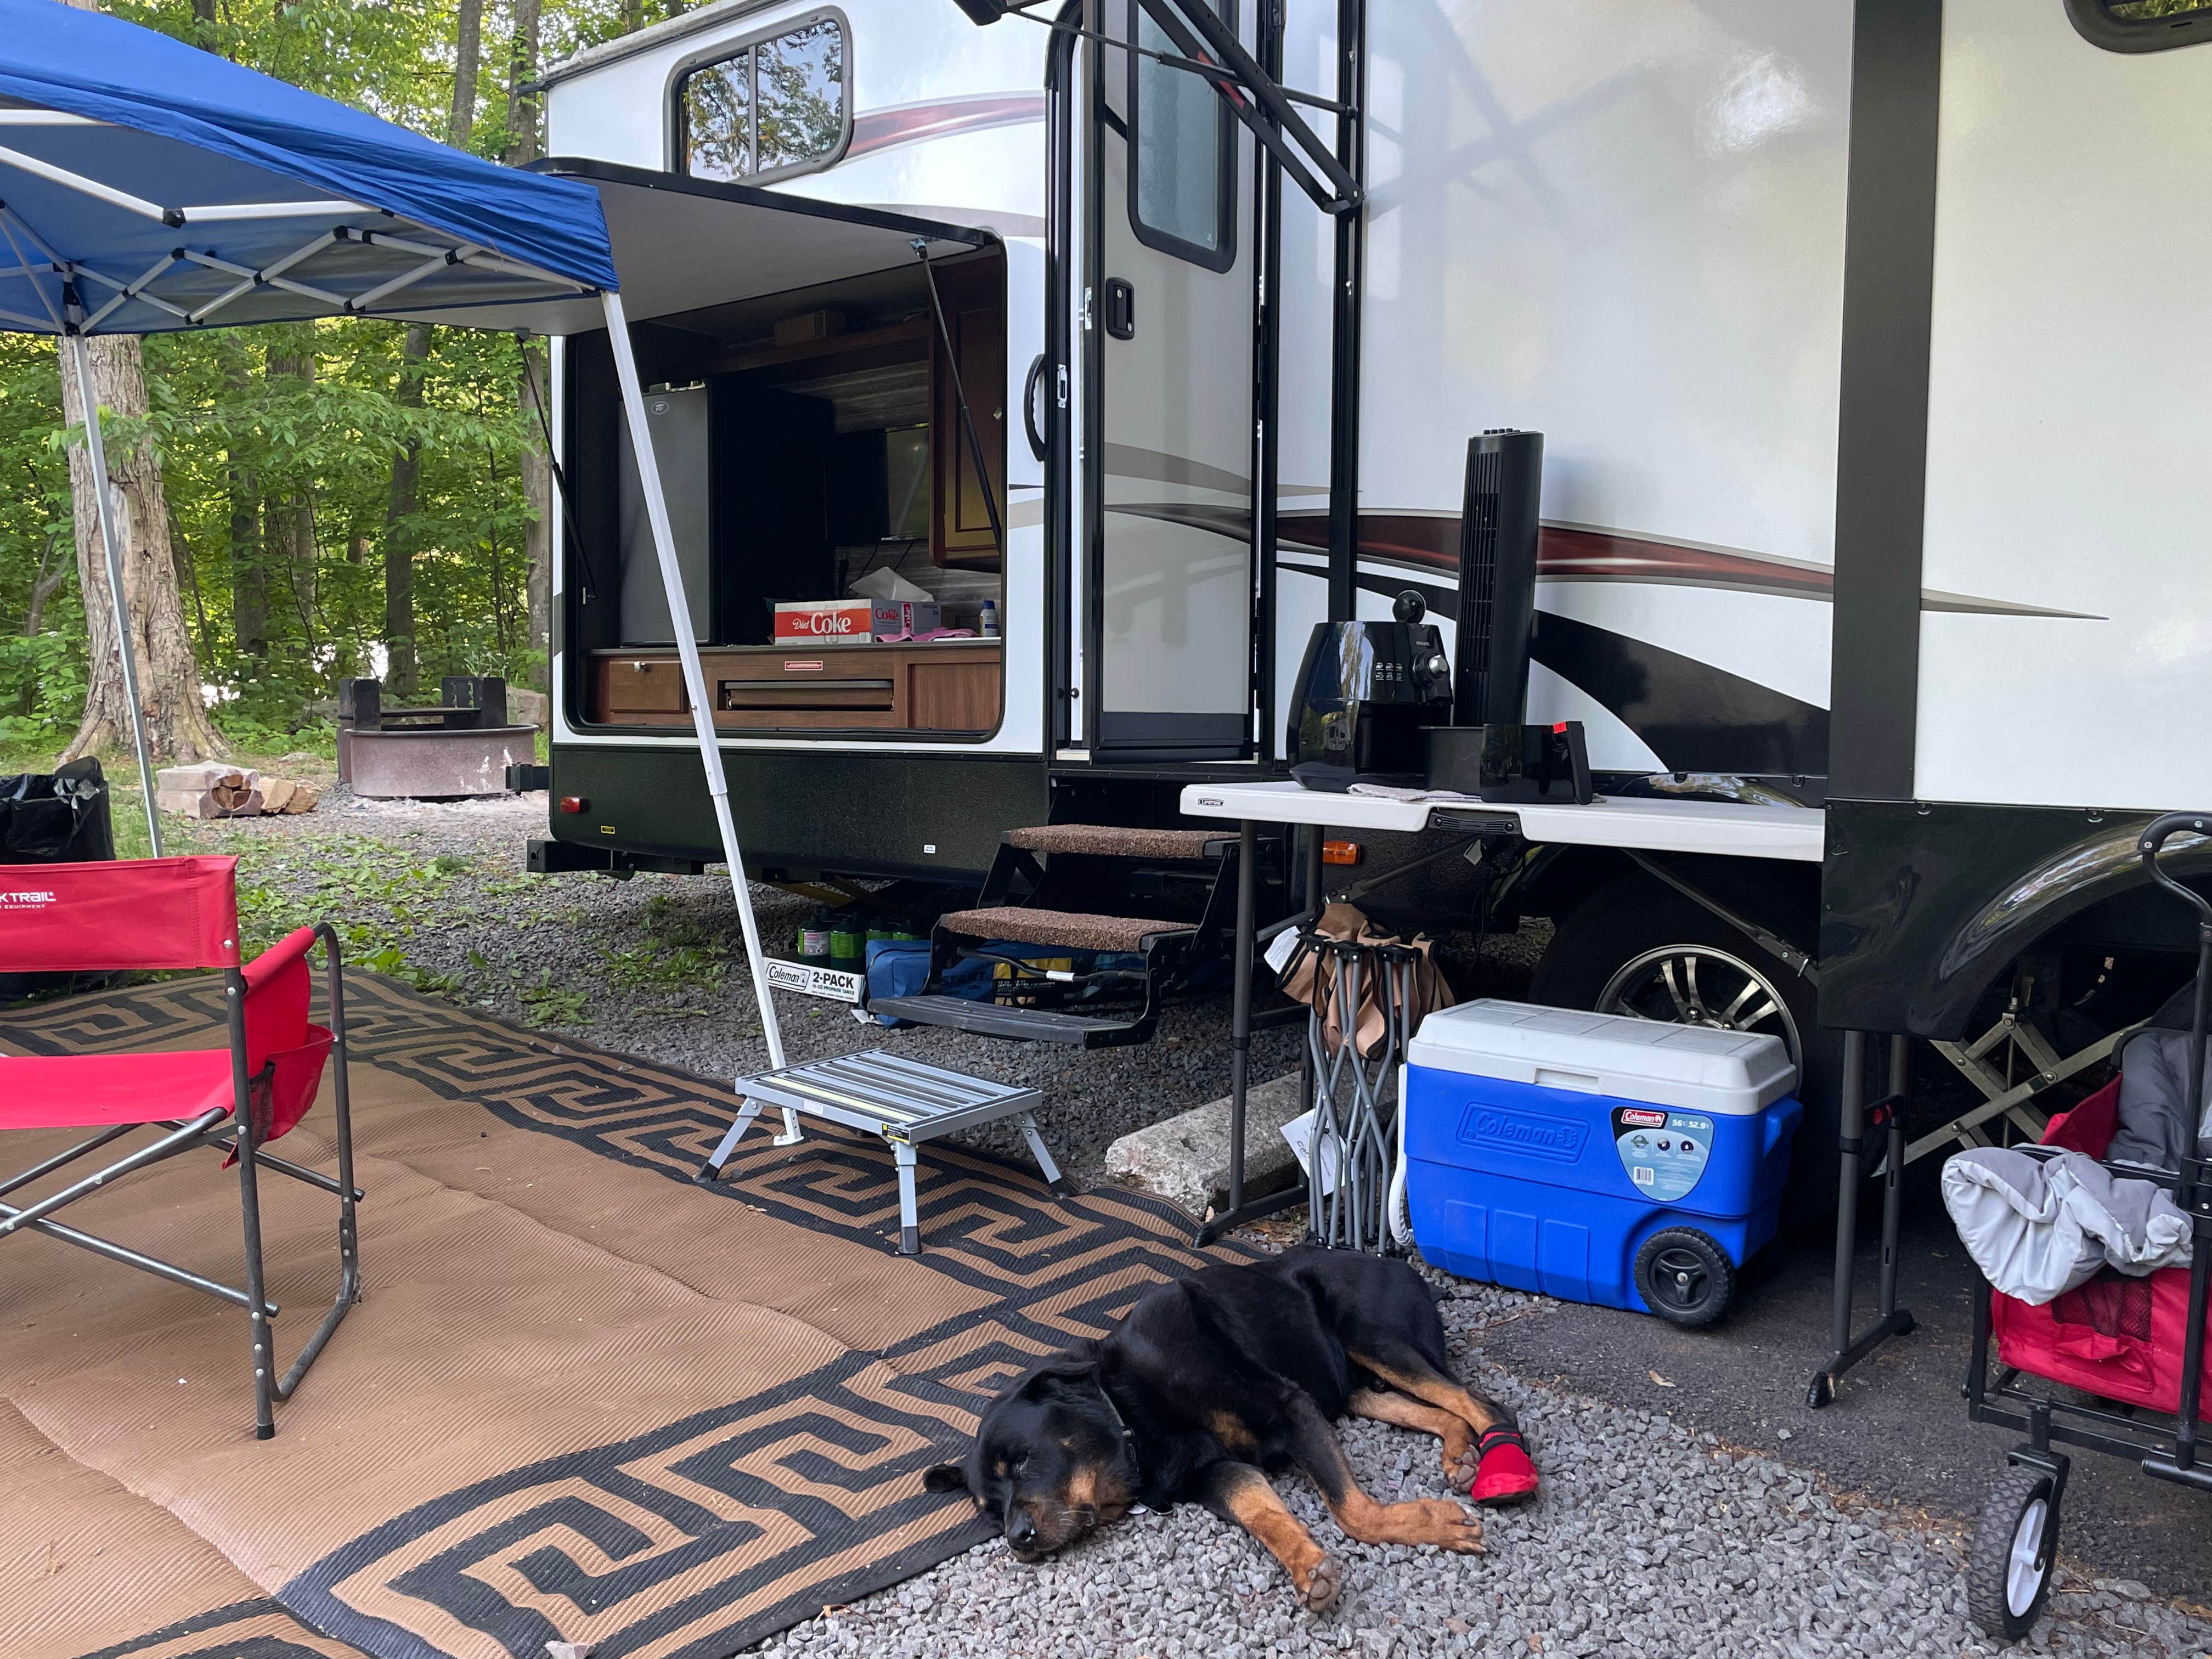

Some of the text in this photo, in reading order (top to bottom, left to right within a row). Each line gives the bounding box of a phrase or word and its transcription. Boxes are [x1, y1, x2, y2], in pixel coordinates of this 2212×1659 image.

[792, 612, 851, 634] Diet Coke
[769, 966, 799, 984] Coleman
[812, 972, 854, 989] 2-PACK
[1625, 1111, 1655, 1122] Coleman
[1476, 1111, 1556, 1146] Coleman
